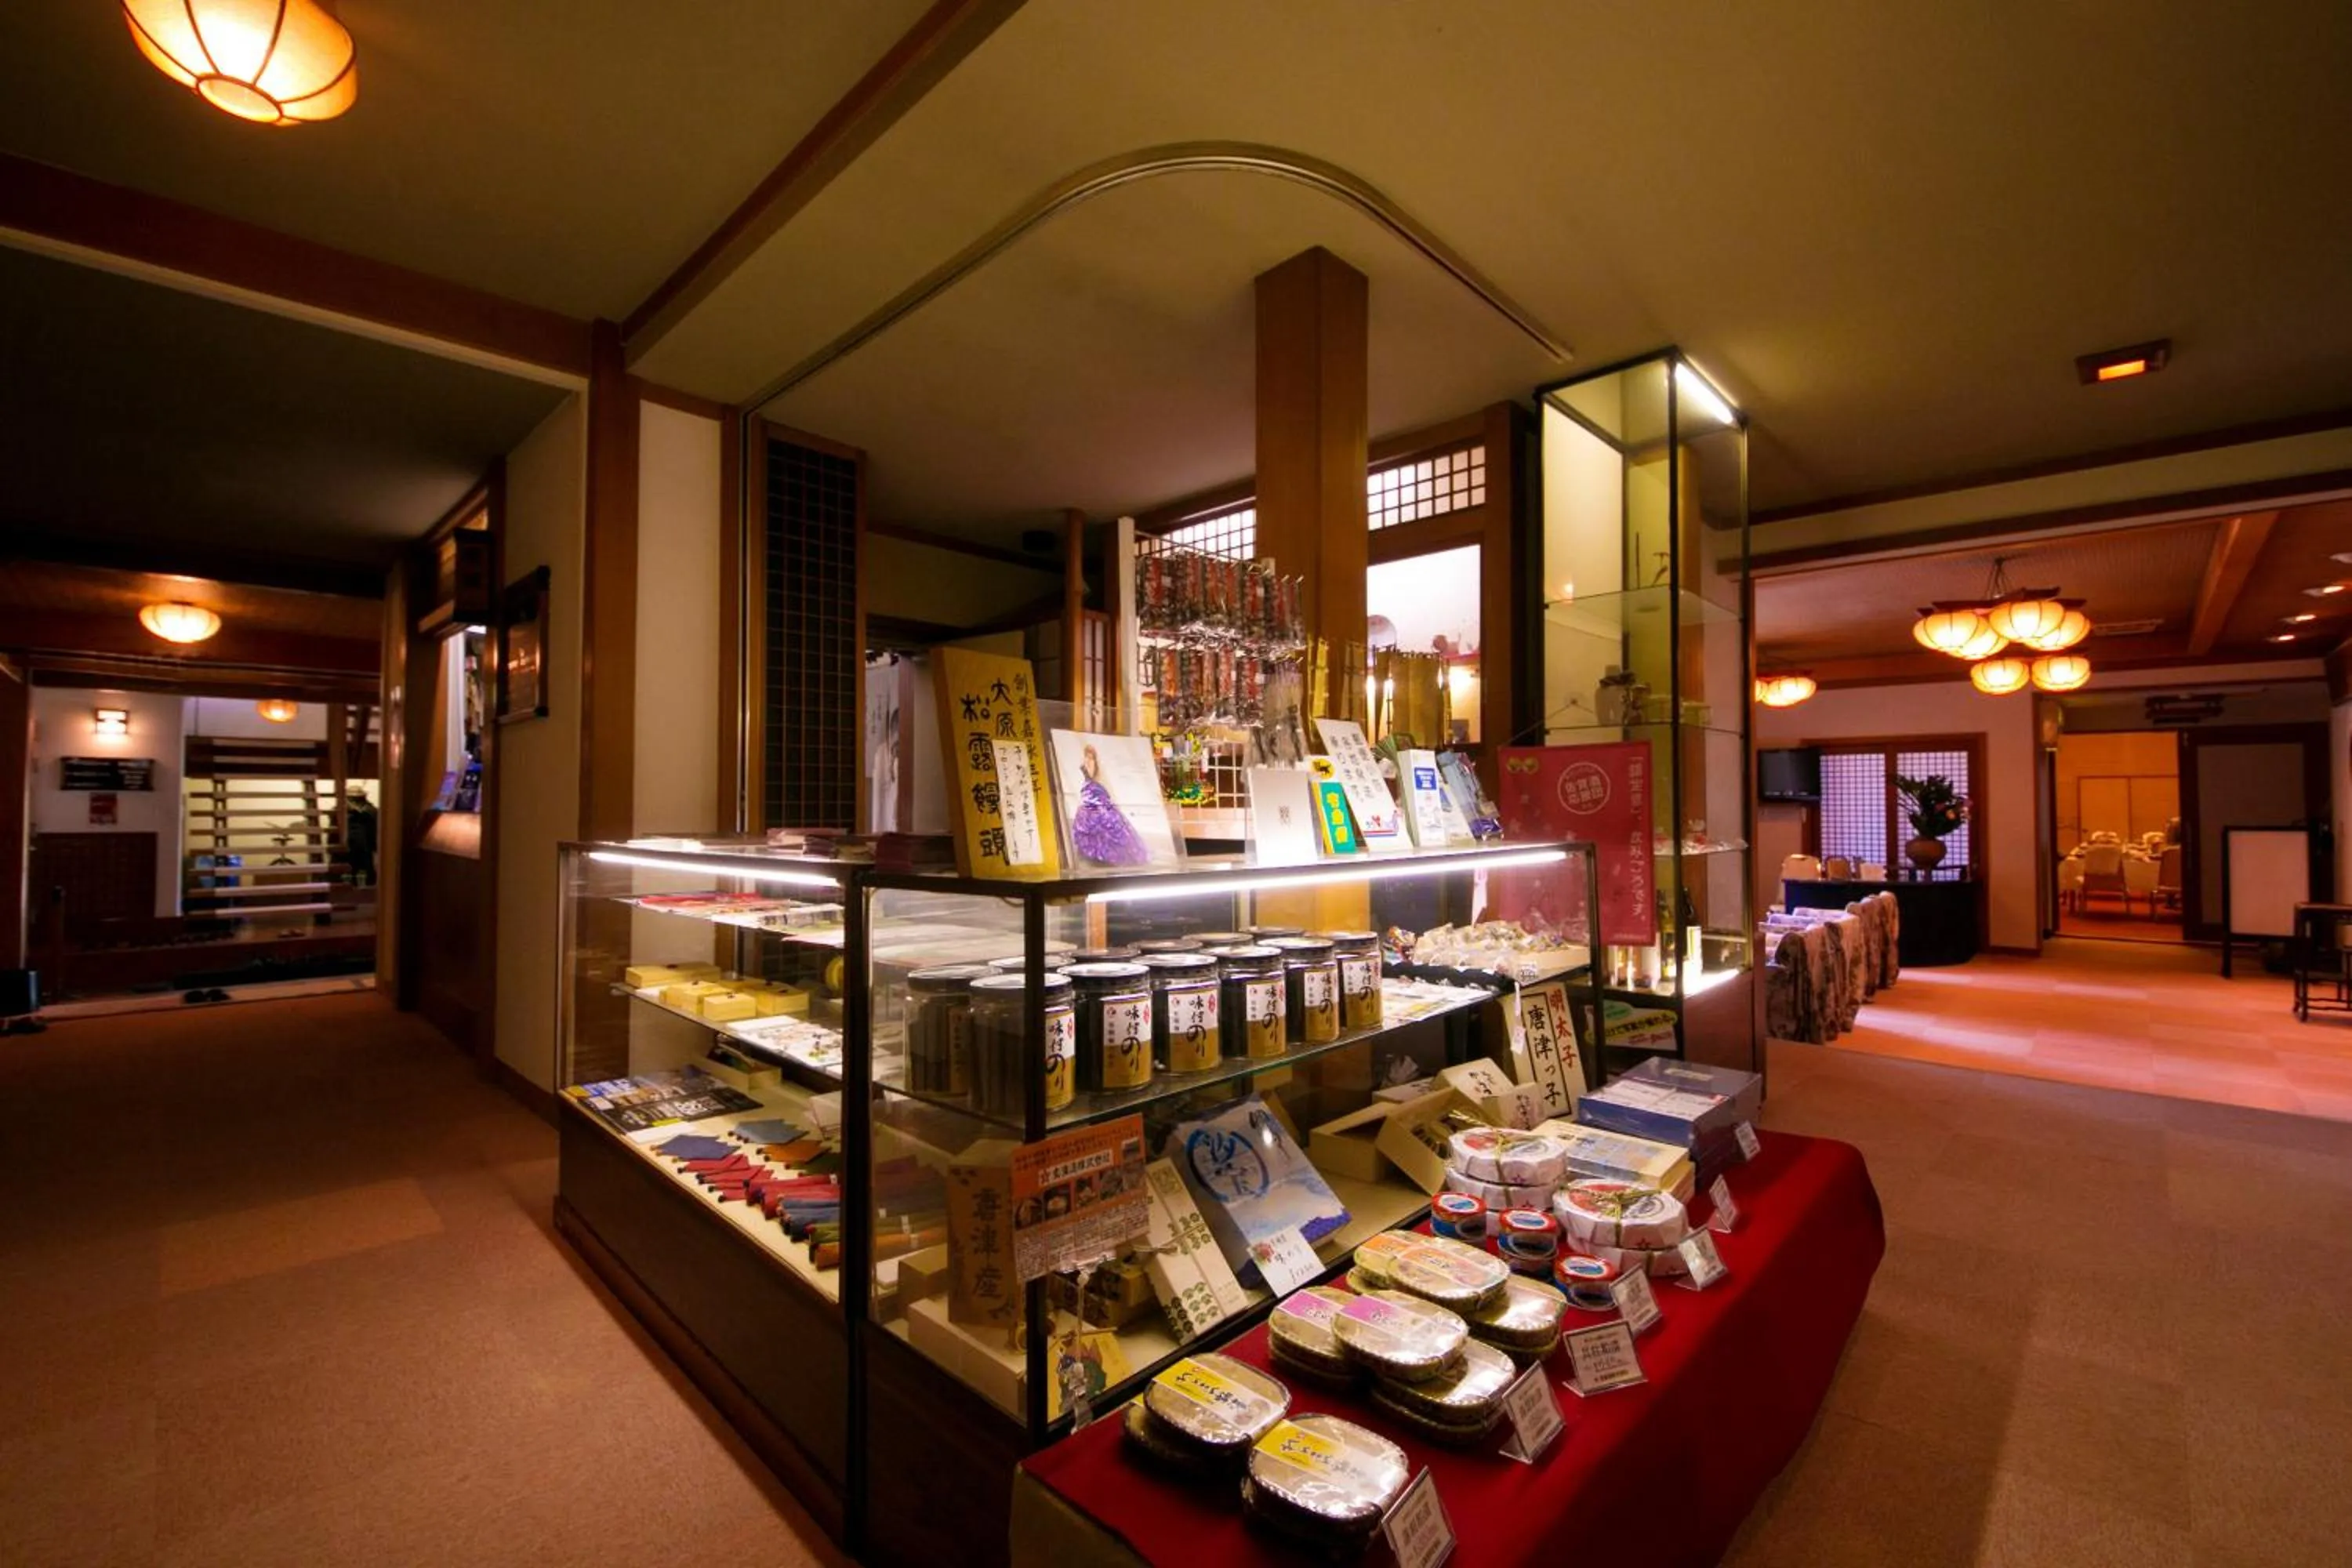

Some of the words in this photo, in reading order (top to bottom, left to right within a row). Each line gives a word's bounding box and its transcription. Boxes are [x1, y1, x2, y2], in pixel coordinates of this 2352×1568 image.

[991, 677, 1017, 737] 大原
[960, 693, 1010, 866] 松露饅頭
[1121, 1005, 1141, 1071] 味付のり
[1186, 995, 1206, 1057] 味付のり
[1262, 985, 1279, 1043] 味付のり
[1549, 989, 1577, 1069] 明太子
[1045, 1019, 1065, 1090] 味付のり
[1528, 1005, 1562, 1108] 唐津っ子
